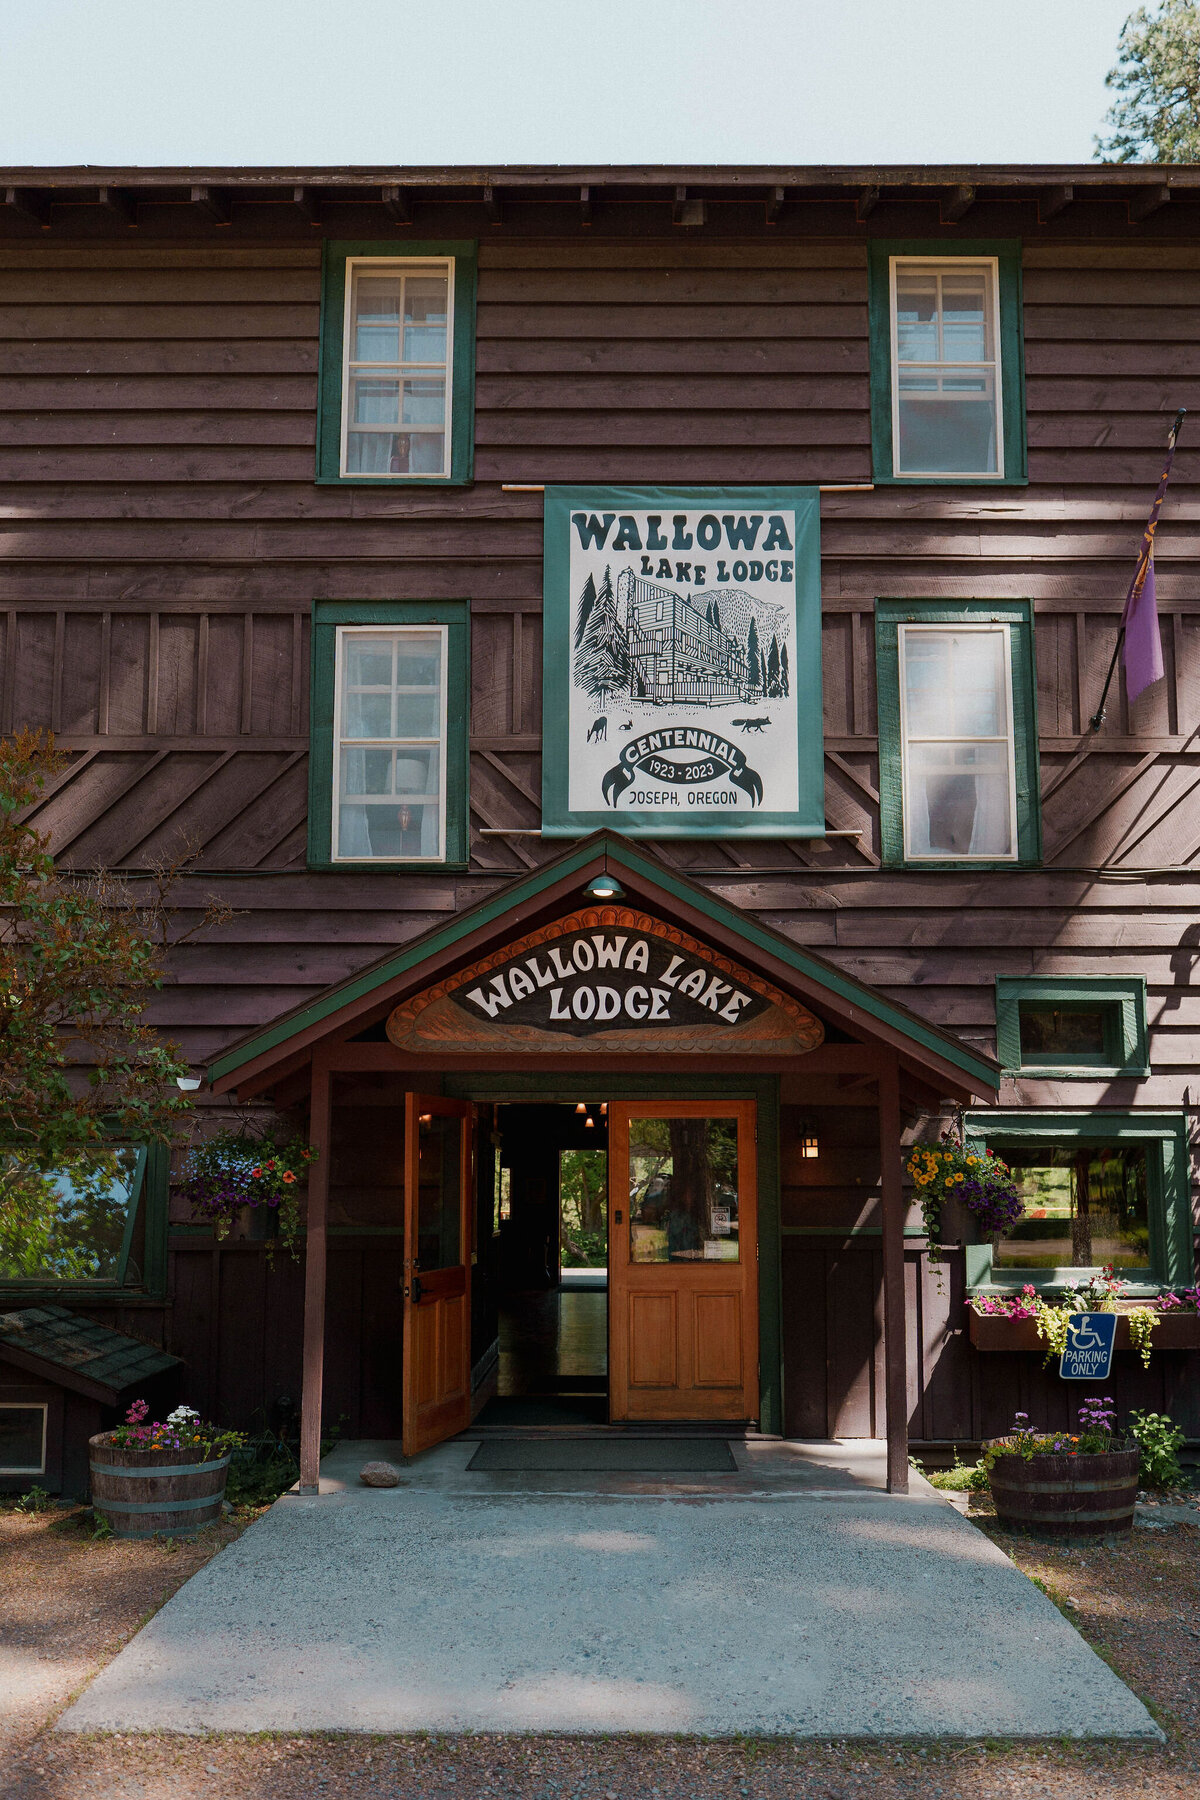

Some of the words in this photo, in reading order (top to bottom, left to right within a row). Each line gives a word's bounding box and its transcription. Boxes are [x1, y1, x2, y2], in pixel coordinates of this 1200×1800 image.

[571, 513, 794, 551] WALLOWA
[640, 555, 707, 585] LAKE
[717, 560, 794, 582] LODGE
[625, 730, 738, 764] CENTENNIAL
[649, 759, 675, 779] 1923
[685, 762, 714, 780] 2023
[629, 791, 681, 806] JOSEPH,
[687, 791, 738, 805] OREGON
[465, 934, 649, 1018] WALLOWA
[658, 955, 752, 1024] LAKE
[549, 985, 672, 1020] LODGE
[1065, 1350, 1108, 1363] PARKING
[1071, 1363, 1099, 1375] ONLY
